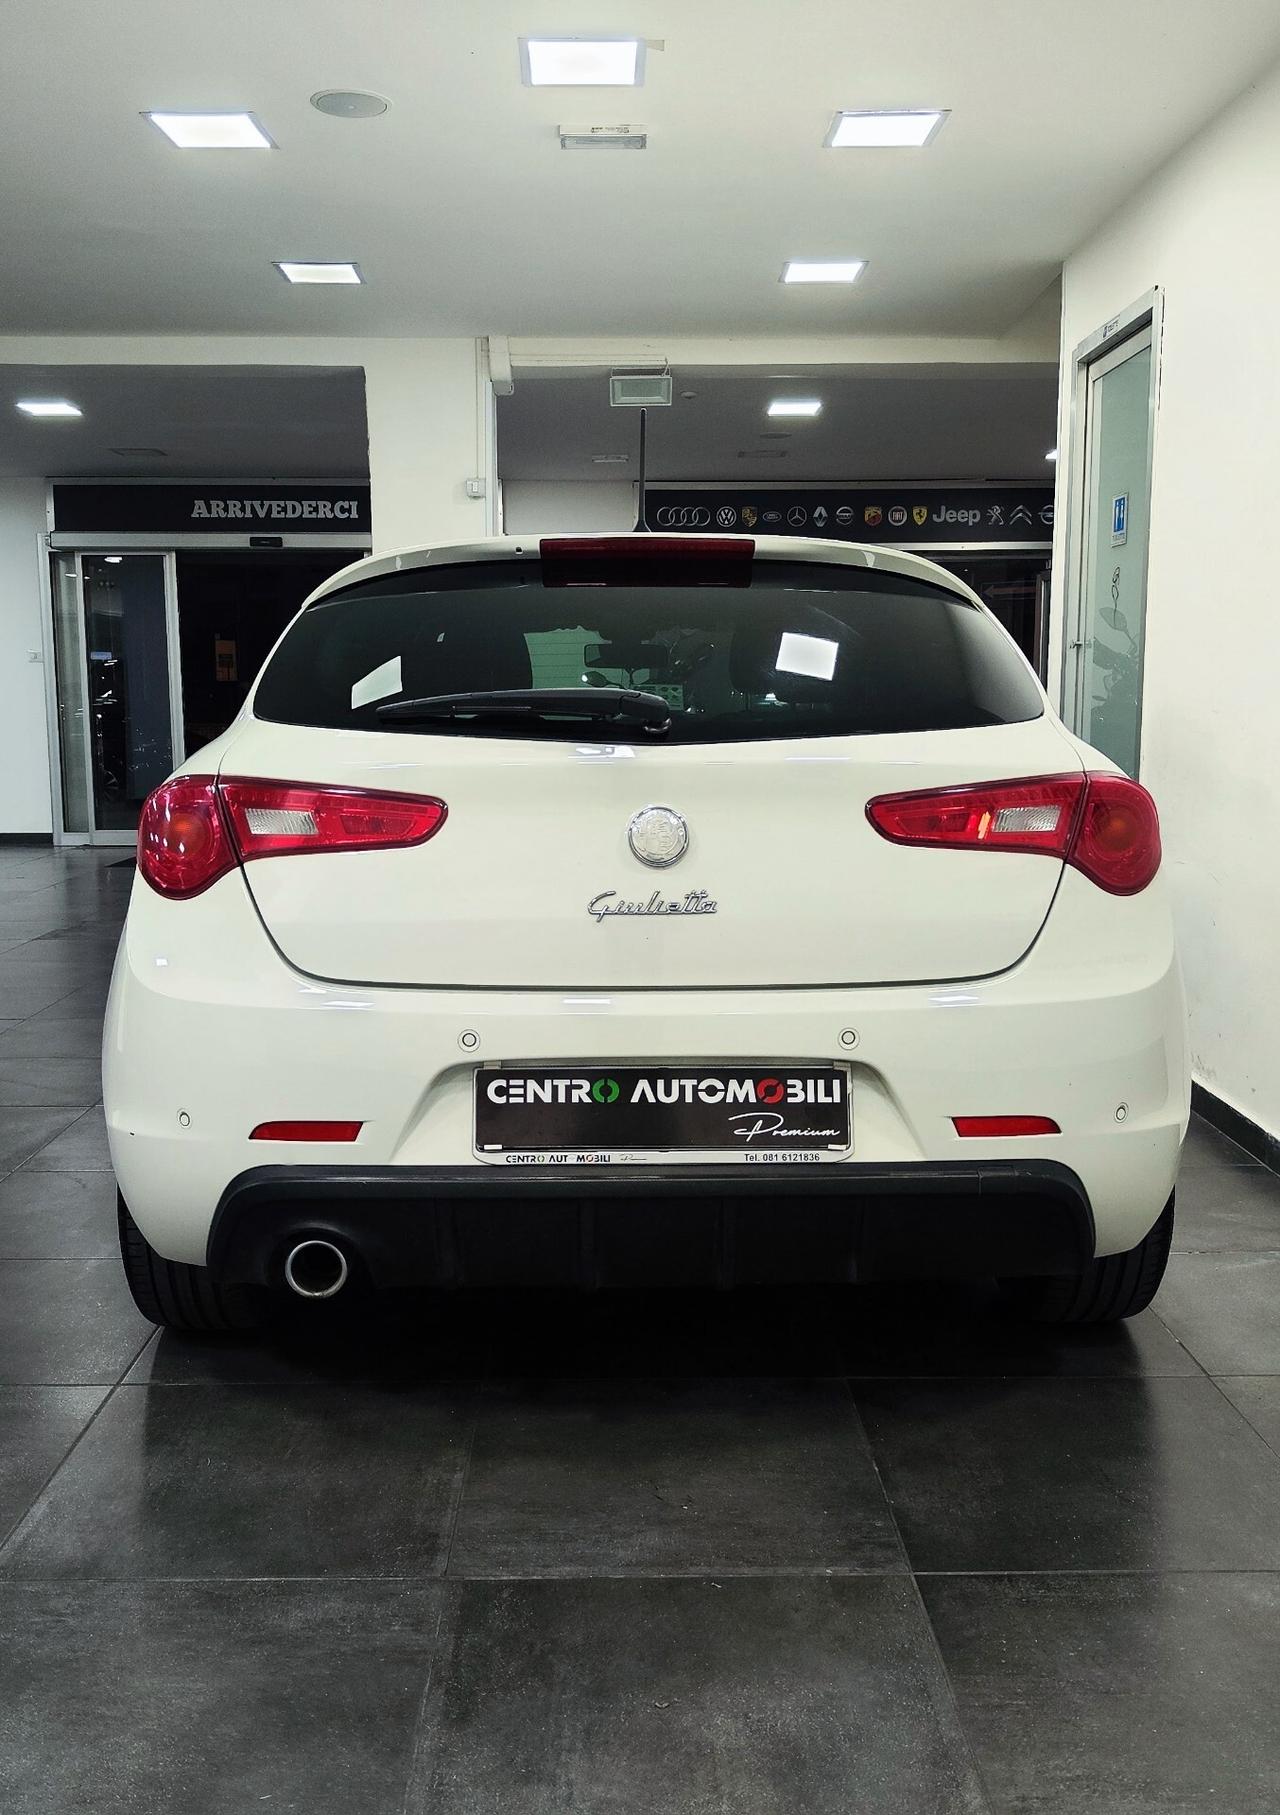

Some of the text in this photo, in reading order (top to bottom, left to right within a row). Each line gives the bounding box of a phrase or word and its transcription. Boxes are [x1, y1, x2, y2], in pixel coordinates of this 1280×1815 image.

[191, 500, 359, 519] ARRIVEDERCI
[932, 505, 981, 526] Jeep
[587, 890, 718, 923] Giulietta
[487, 1078, 841, 1105] CENTRO AUTOMOBILI
[728, 1112, 841, 1142] Premium
[506, 1155, 545, 1163] CENTRO
[744, 1153, 821, 1162] Tel. 081 6121836
